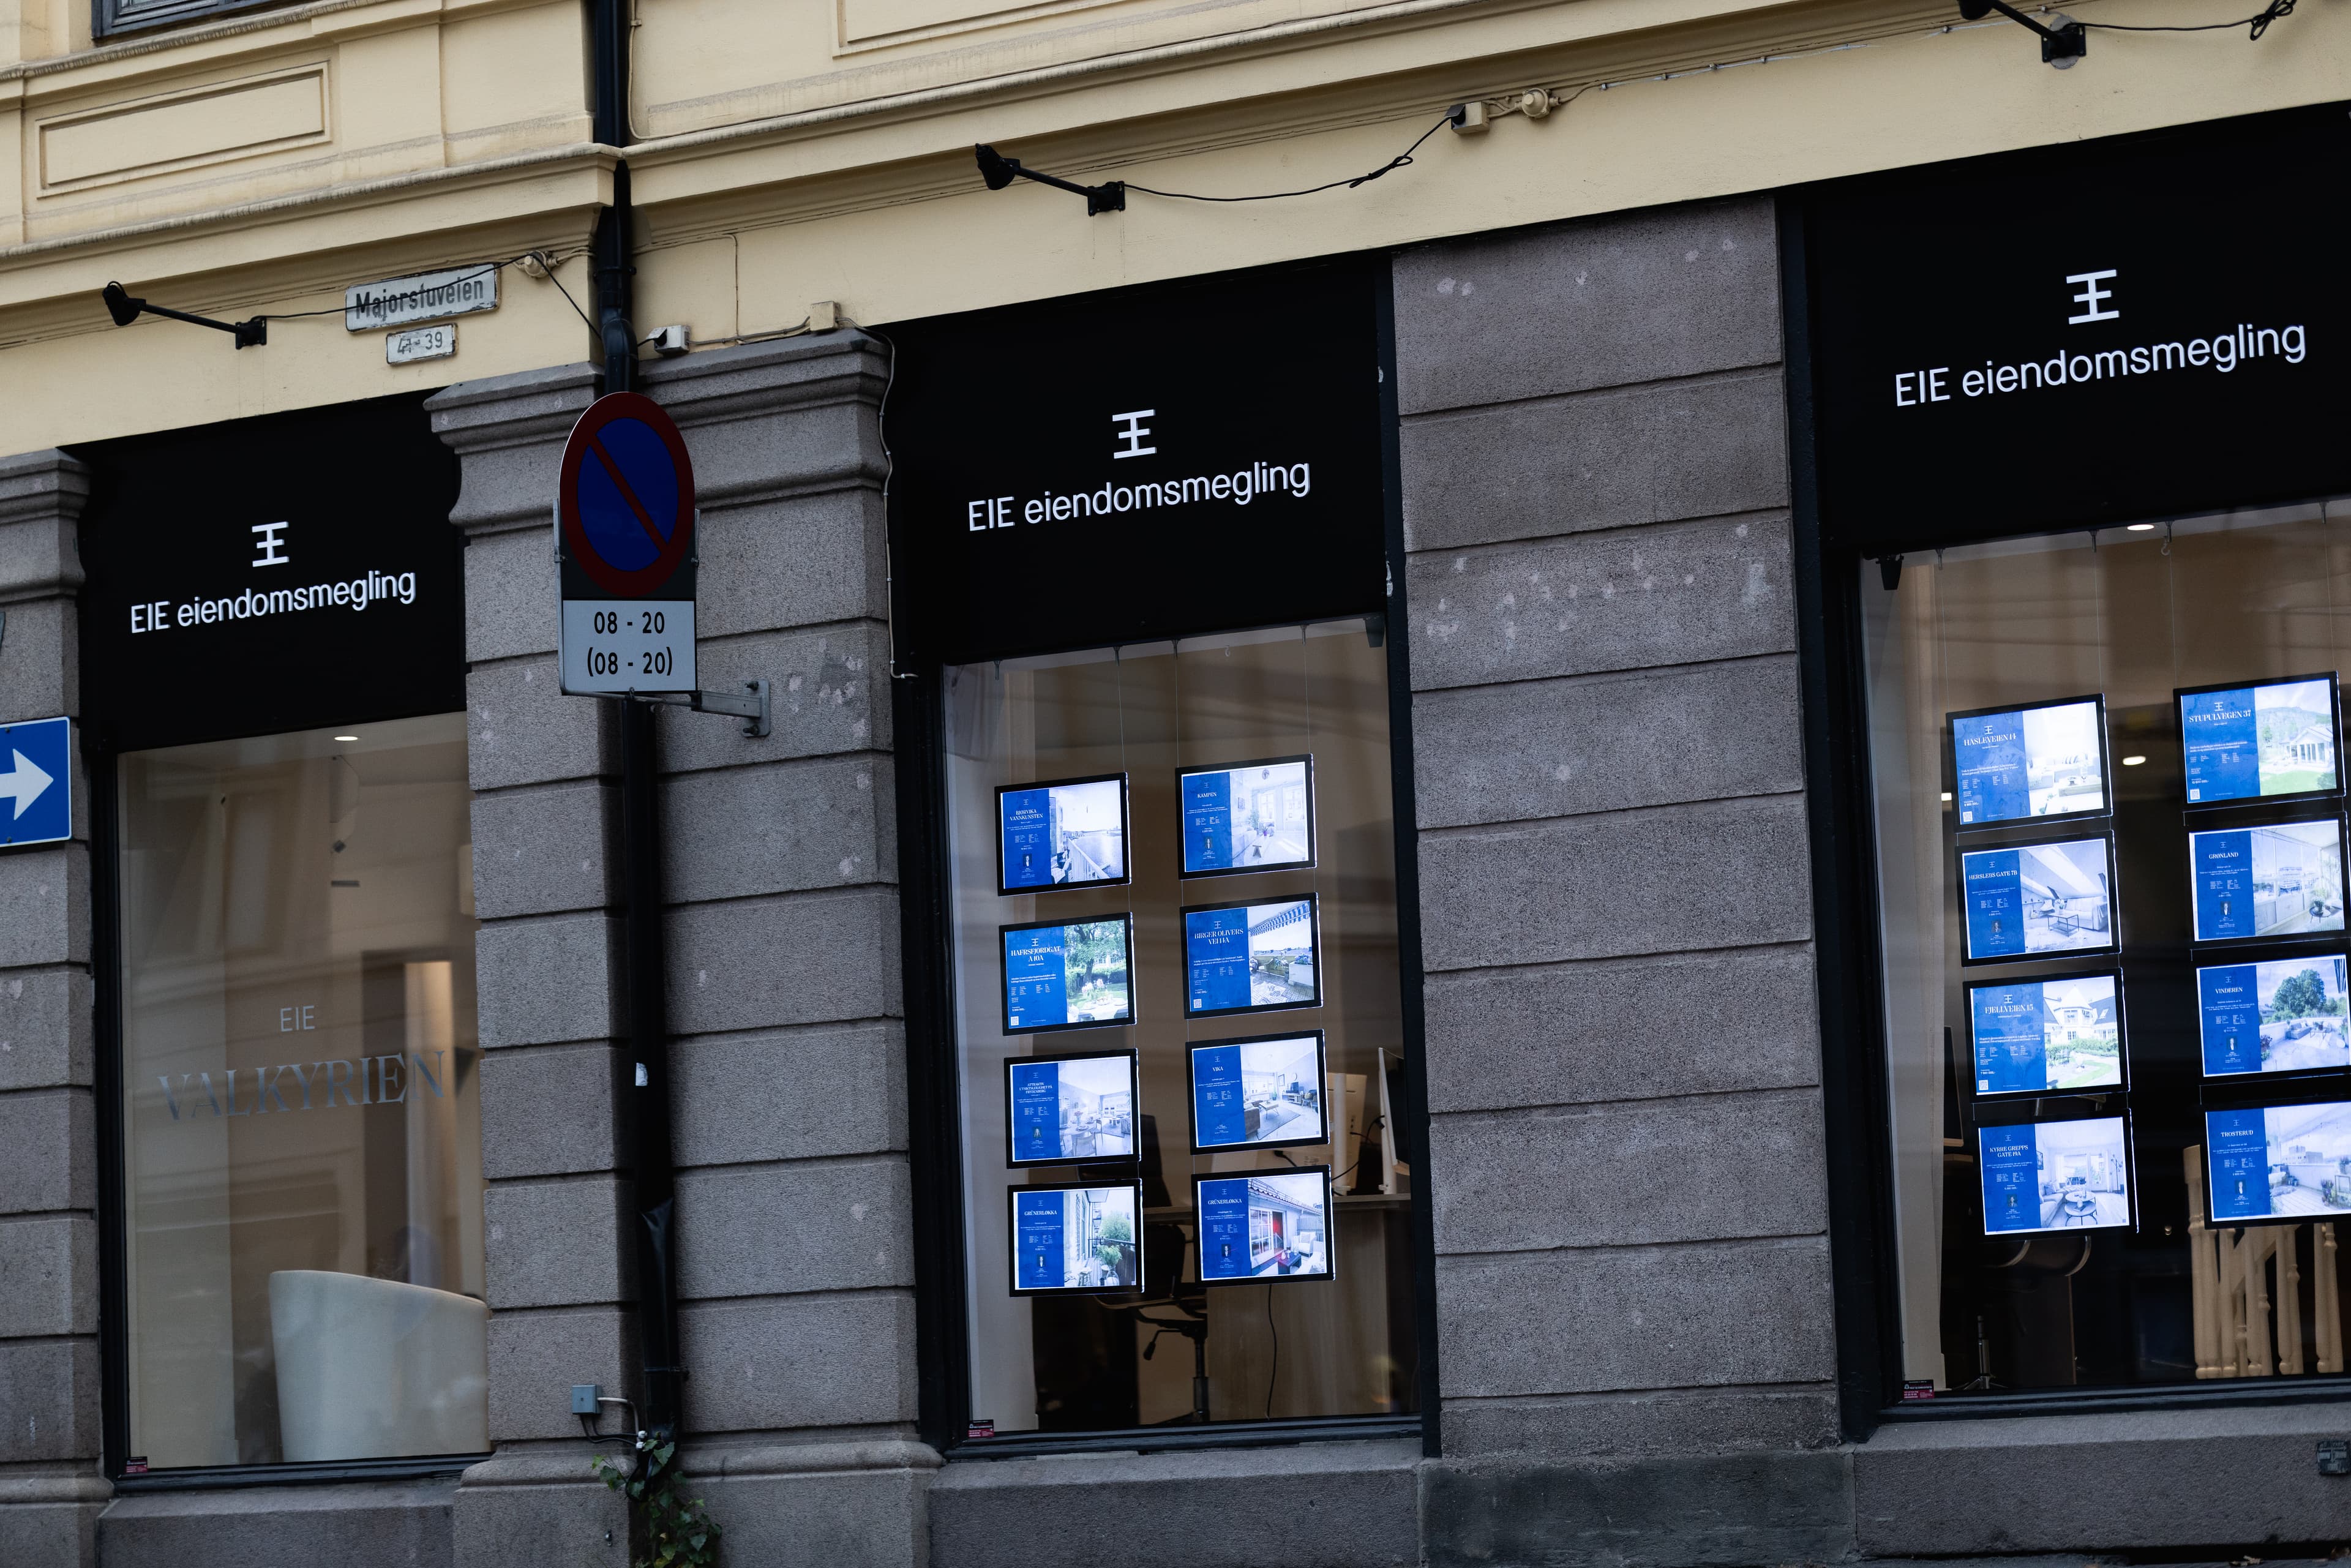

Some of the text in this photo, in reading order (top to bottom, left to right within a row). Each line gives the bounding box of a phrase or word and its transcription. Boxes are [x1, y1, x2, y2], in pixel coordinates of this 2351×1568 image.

[355, 277, 484, 321] Majorstuveien
[1895, 323, 2306, 407] EIE eiendomsmegling
[969, 462, 1310, 531] EIE eiendomsmegling
[130, 570, 416, 634] EIE eiendomsmegling
[594, 611, 618, 634] 08
[642, 611, 665, 634] 20
[587, 647, 618, 677] (08
[643, 647, 672, 676] 20)
[1964, 734, 2008, 746] HASLEVEIEN
[1969, 872, 1996, 880] HERSLEBS
[1194, 928, 1243, 939] BIRGER OLIVERS
[1011, 945, 1061, 956] HAFRSFJORDGAT
[280, 1005, 315, 1032] EIE
[1985, 1005, 2026, 1015] FJELLVEIEN
[157, 1051, 445, 1120] VALKYRIEN
